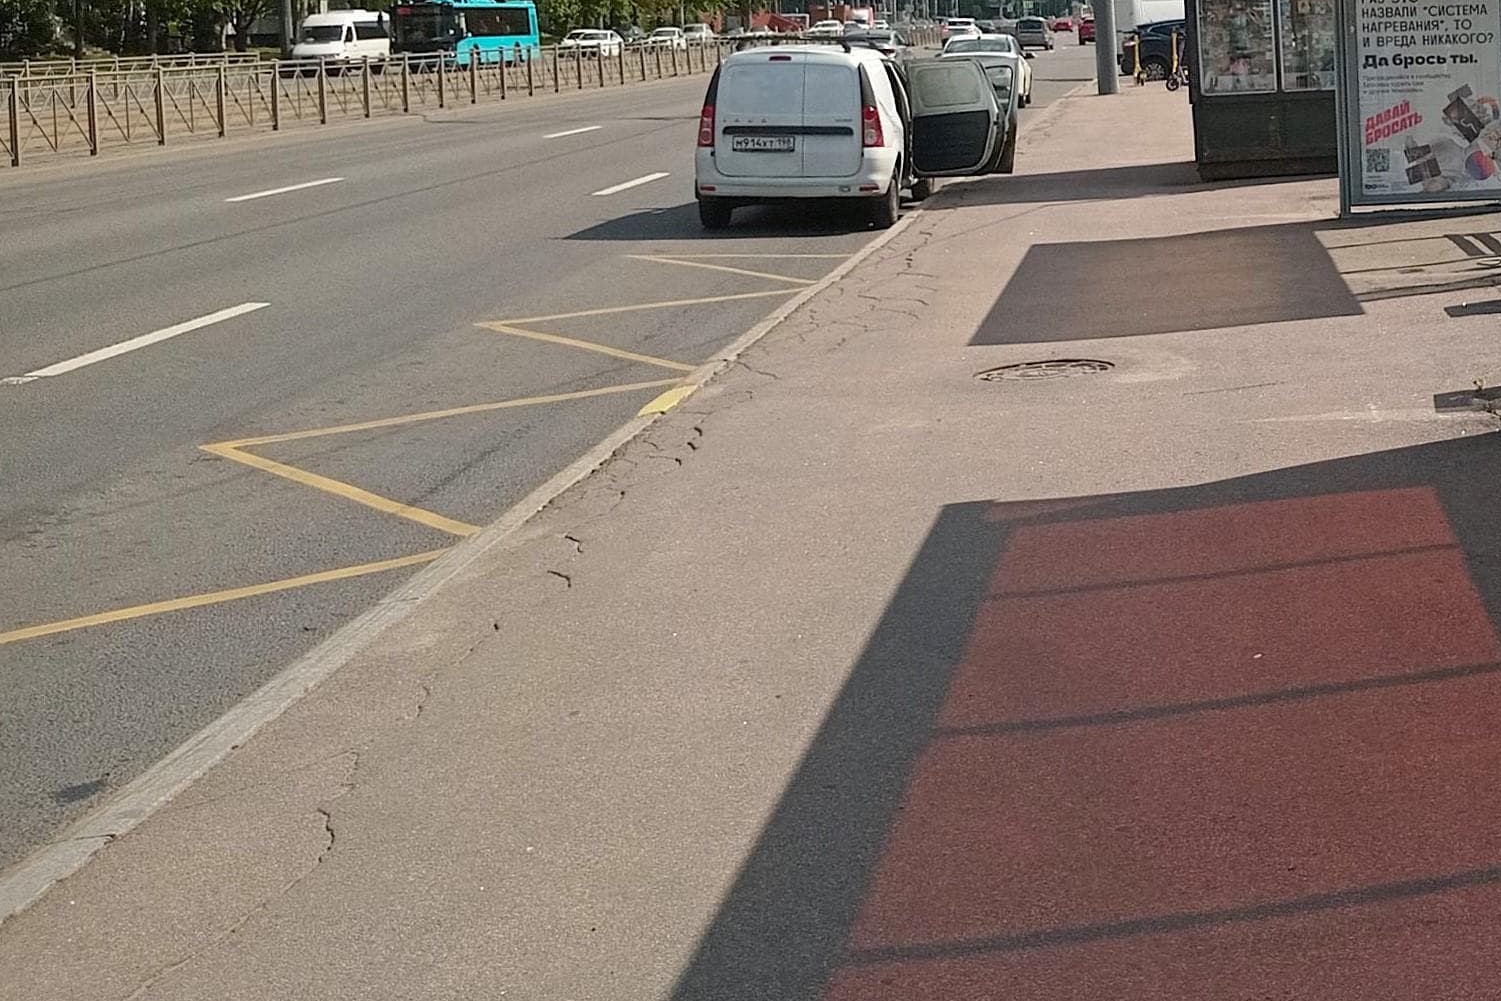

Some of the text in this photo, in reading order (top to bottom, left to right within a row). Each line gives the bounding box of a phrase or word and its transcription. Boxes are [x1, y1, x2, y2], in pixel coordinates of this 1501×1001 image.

[1361, 3, 1488, 18] НАЗВАЛИ "СИСТЕМА
[1454, 19, 1473, 31] ТО
[1363, 32, 1494, 47] И ВРЕДА НИКАКОГО?
[1362, 53, 1479, 69] Да брось ты.
[1365, 99, 1410, 132] ДАВАЙ
[1365, 112, 1423, 146] БРОСАТЬ
